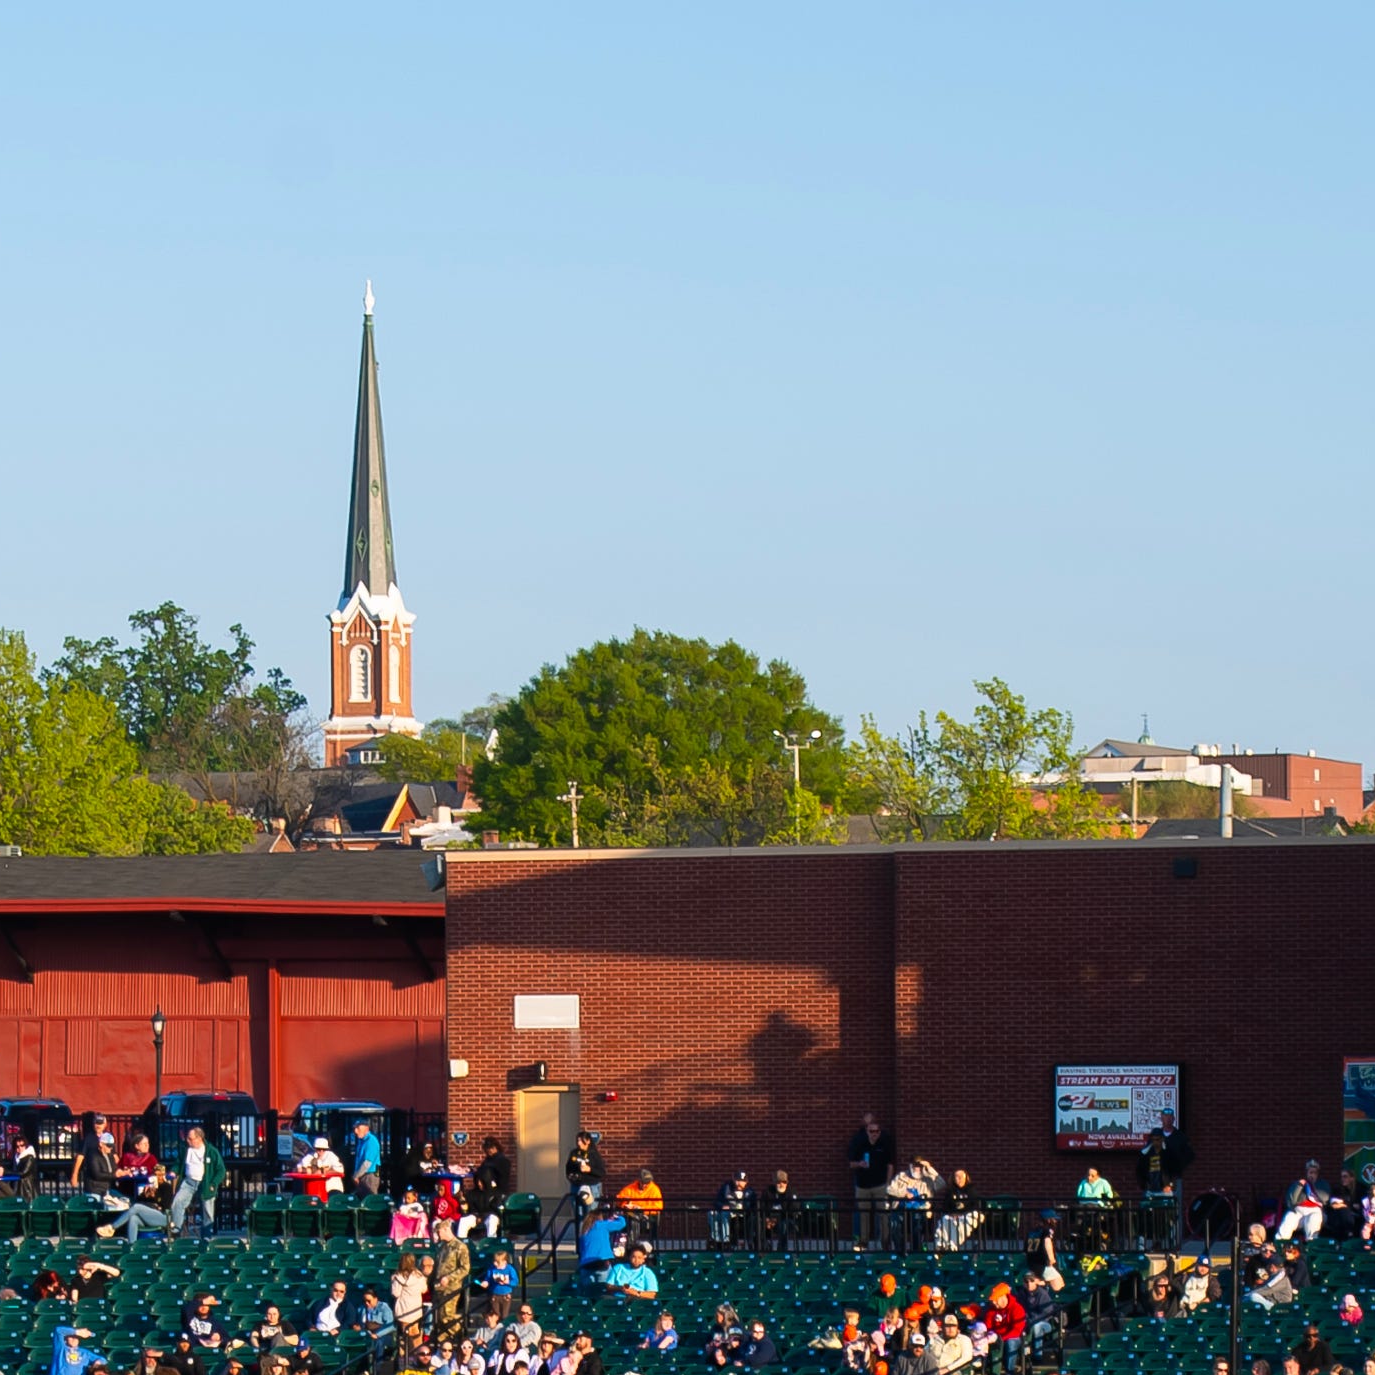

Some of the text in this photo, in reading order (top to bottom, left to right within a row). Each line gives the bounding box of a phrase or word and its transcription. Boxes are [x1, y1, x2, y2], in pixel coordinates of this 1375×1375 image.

[1060, 1076, 1173, 1085] STREAM FOR FREE 24/7
